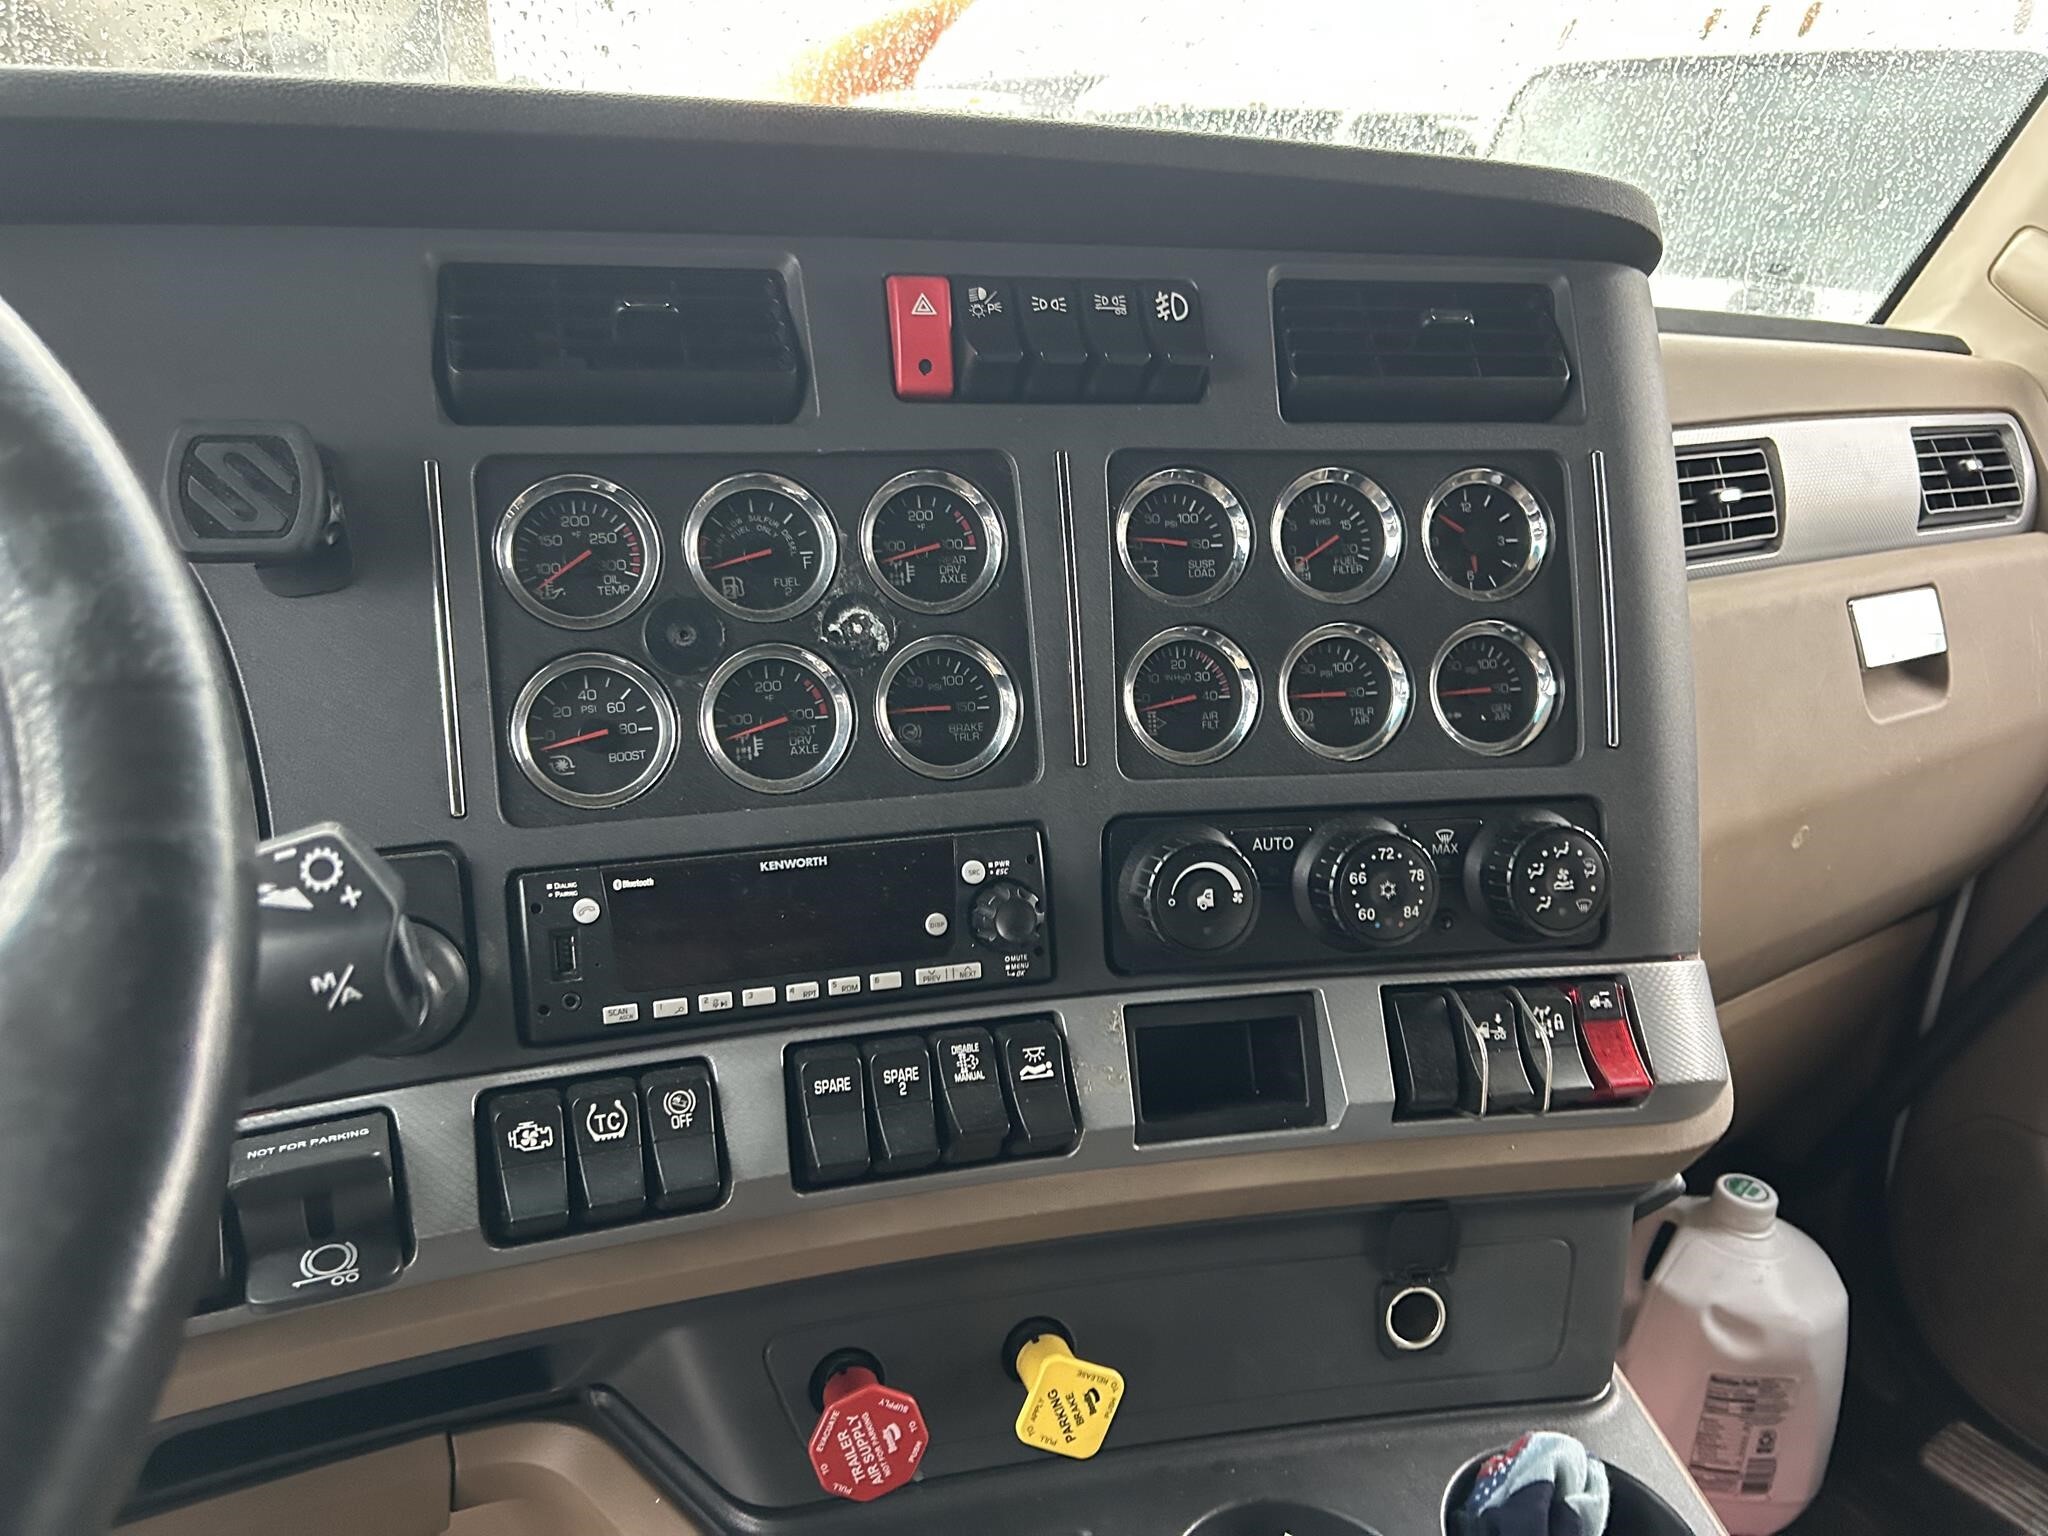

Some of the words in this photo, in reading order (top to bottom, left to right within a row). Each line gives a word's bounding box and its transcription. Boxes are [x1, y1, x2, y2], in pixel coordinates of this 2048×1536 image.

[1313, 503, 1326, 515] 10
[1461, 502, 1472, 512] 12
[561, 515, 590, 527] 200
[907, 510, 934, 522] 200
[1177, 513, 1199, 524] 100
[1339, 519, 1353, 531] 15
[589, 532, 618, 545] 250
[942, 538, 963, 550] 00
[1188, 539, 1210, 550] 50
[1497, 536, 1505, 546] 3
[802, 555, 813, 570] F
[1188, 559, 1216, 569] SUSP
[1335, 556, 1358, 565] FUEL
[939, 565, 962, 576] DRV
[1188, 568, 1216, 578] LOAD
[1333, 564, 1364, 575] FILTER
[603, 574, 621, 585] OIL
[773, 576, 801, 588] FUEL
[940, 574, 968, 585] AXLE
[1467, 571, 1475, 581] 6
[597, 584, 630, 597] TEMP
[1170, 659, 1187, 670] 20
[1332, 662, 1354, 673] 100
[1478, 659, 1498, 670] 100
[943, 675, 964, 686] 100
[1194, 671, 1211, 682] 30
[755, 680, 782, 693] 200
[1347, 687, 1366, 698] 50
[578, 689, 597, 701] 40
[553, 706, 573, 718] 20
[581, 705, 598, 714] PSI
[606, 701, 627, 714] 60
[1350, 706, 1375, 716] TRLR
[1202, 711, 1219, 720] AIR
[949, 722, 984, 732] BRAKE
[1201, 720, 1219, 729] FILT
[1354, 717, 1371, 727] AIR
[790, 736, 813, 746] DRV
[954, 732, 981, 742] TRLR
[790, 744, 820, 756] AXLE
[608, 750, 647, 763] BOOST
[1252, 837, 1294, 852] AUTO
[1432, 843, 1459, 856] MAX
[1378, 848, 1395, 860] 72
[760, 856, 828, 873] KENWORTH
[994, 860, 1010, 868] PWR
[995, 867, 1009, 876] ESC
[1409, 870, 1425, 882] 78
[622, 877, 655, 889] Bluetooth
[1349, 872, 1367, 885] 66
[1358, 908, 1376, 921] 60
[1403, 906, 1420, 918] 84
[1010, 953, 1028, 962] MUTE
[1010, 962, 1029, 970] MENU
[921, 974, 940, 984] PREV
[959, 970, 977, 979] NEXT
[832, 981, 838, 989] 5
[841, 983, 859, 993] RDM
[802, 990, 817, 999] RPT
[704, 997, 709, 1005] 2
[608, 1007, 628, 1017] SCAN
[951, 1042, 979, 1056] DISABLE
[883, 1066, 919, 1085] SPARE
[954, 1070, 986, 1083] MANUAL
[814, 1076, 852, 1095] SPARE
[899, 1082, 907, 1097] 2
[593, 1111, 621, 1133] TC
[670, 1113, 693, 1130] OFF
[247, 1147, 276, 1160] NOT
[278, 1140, 307, 1154] FOR
[310, 1128, 370, 1147] PARKING
[1076, 1369, 1110, 1386] RELEASE
[878, 1398, 910, 1414] SUPPLY
[1065, 1391, 1085, 1427] BRAKE
[1047, 1388, 1077, 1444] PARKING
[861, 1411, 879, 1445] PARKING
[846, 1414, 875, 1464] SUPPLY
[1040, 1435, 1058, 1447] PULL
[836, 1429, 866, 1484] TRAILER
[874, 1445, 885, 1461] FOR
[866, 1463, 884, 1484] AIR
[879, 1460, 892, 1478] NOT
[832, 1482, 853, 1495] PULL
